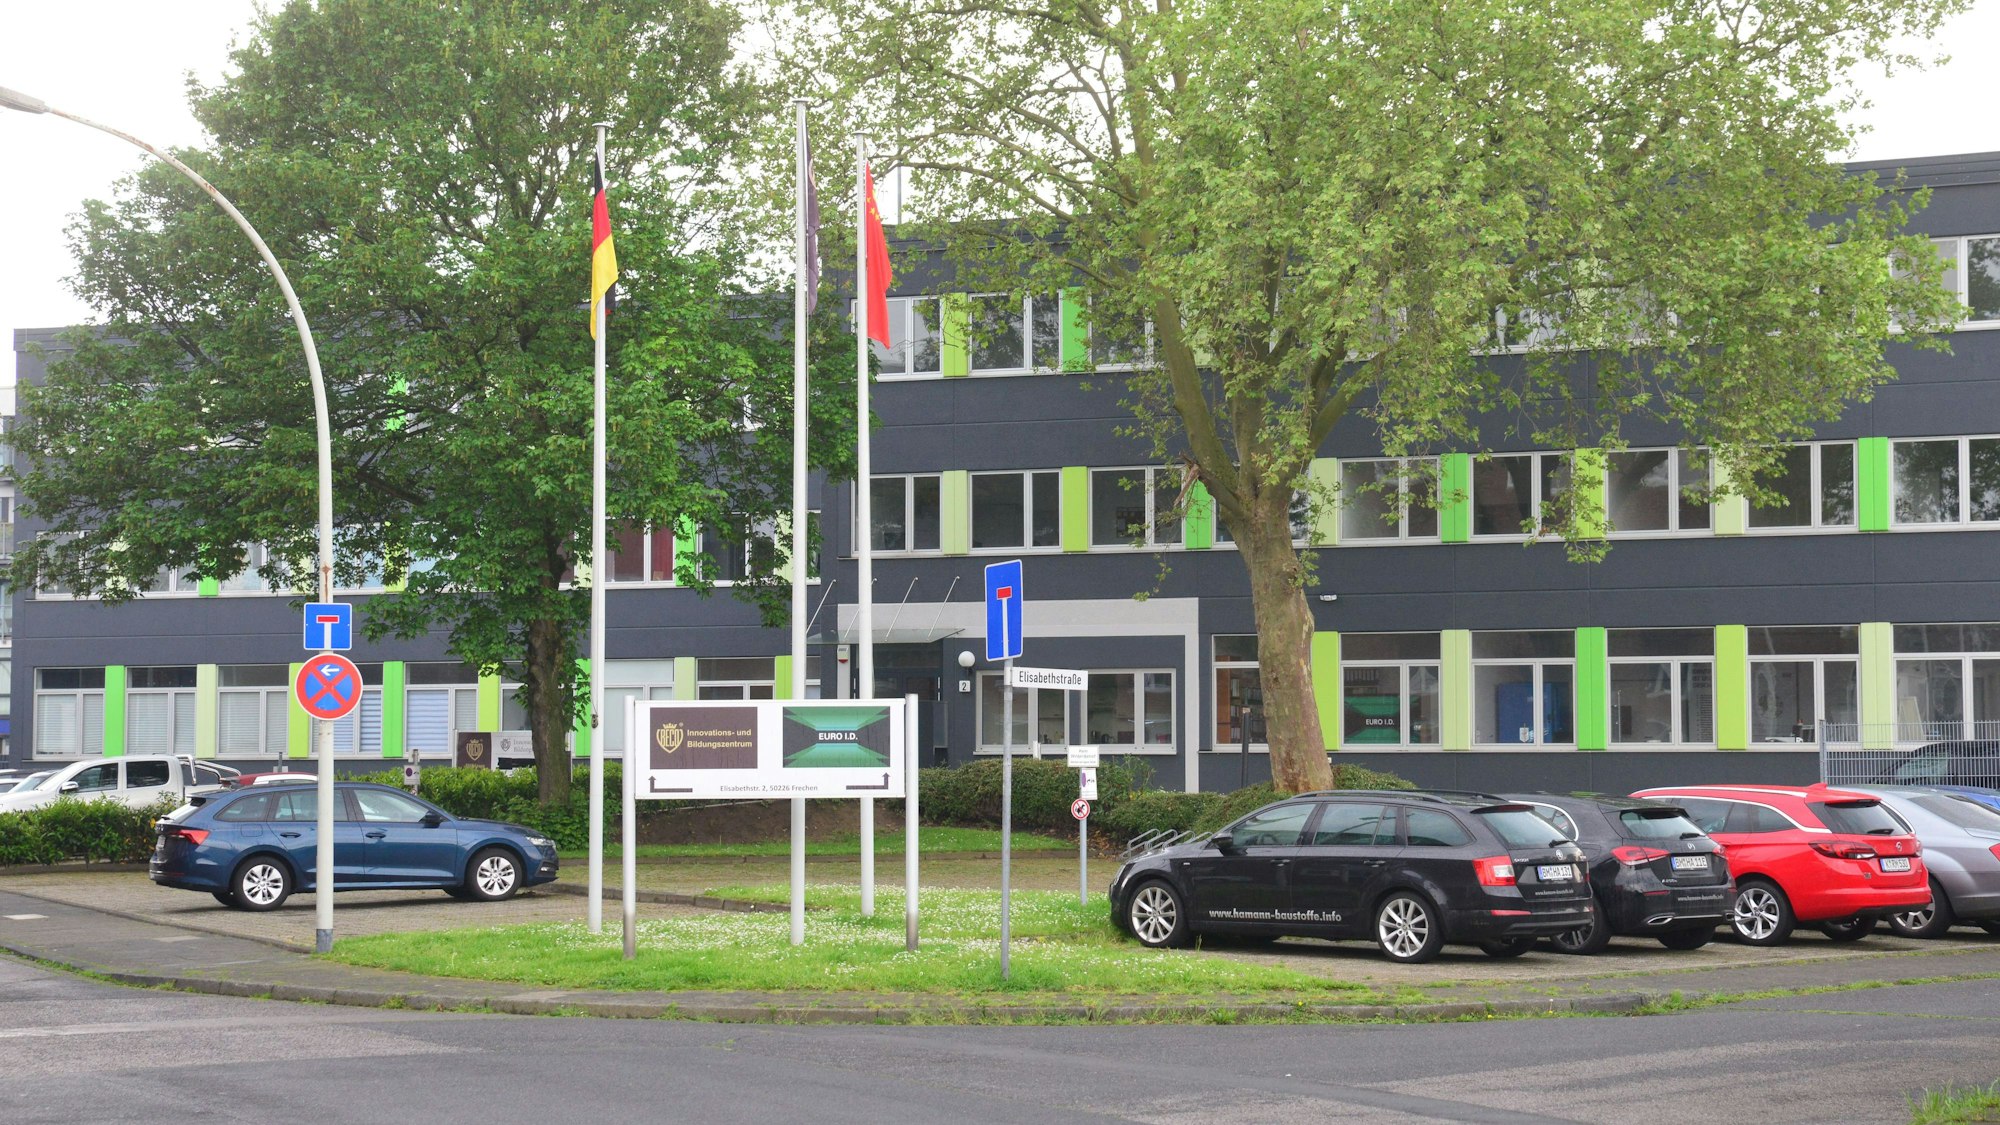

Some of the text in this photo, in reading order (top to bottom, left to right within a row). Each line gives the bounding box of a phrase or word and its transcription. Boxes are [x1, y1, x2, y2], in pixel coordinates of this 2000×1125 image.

[1019, 670, 1082, 685] Elisabethstraße
[962, 682, 967, 691] 2
[686, 728, 752, 737] Innovations- und
[818, 732, 858, 741] EURO I.D.
[687, 740, 752, 749] Bildungszentrum
[769, 784, 790, 792] 50226
[791, 784, 818, 792] Frechen
[1208, 907, 1343, 922] www.hamann-baustoffe.info
